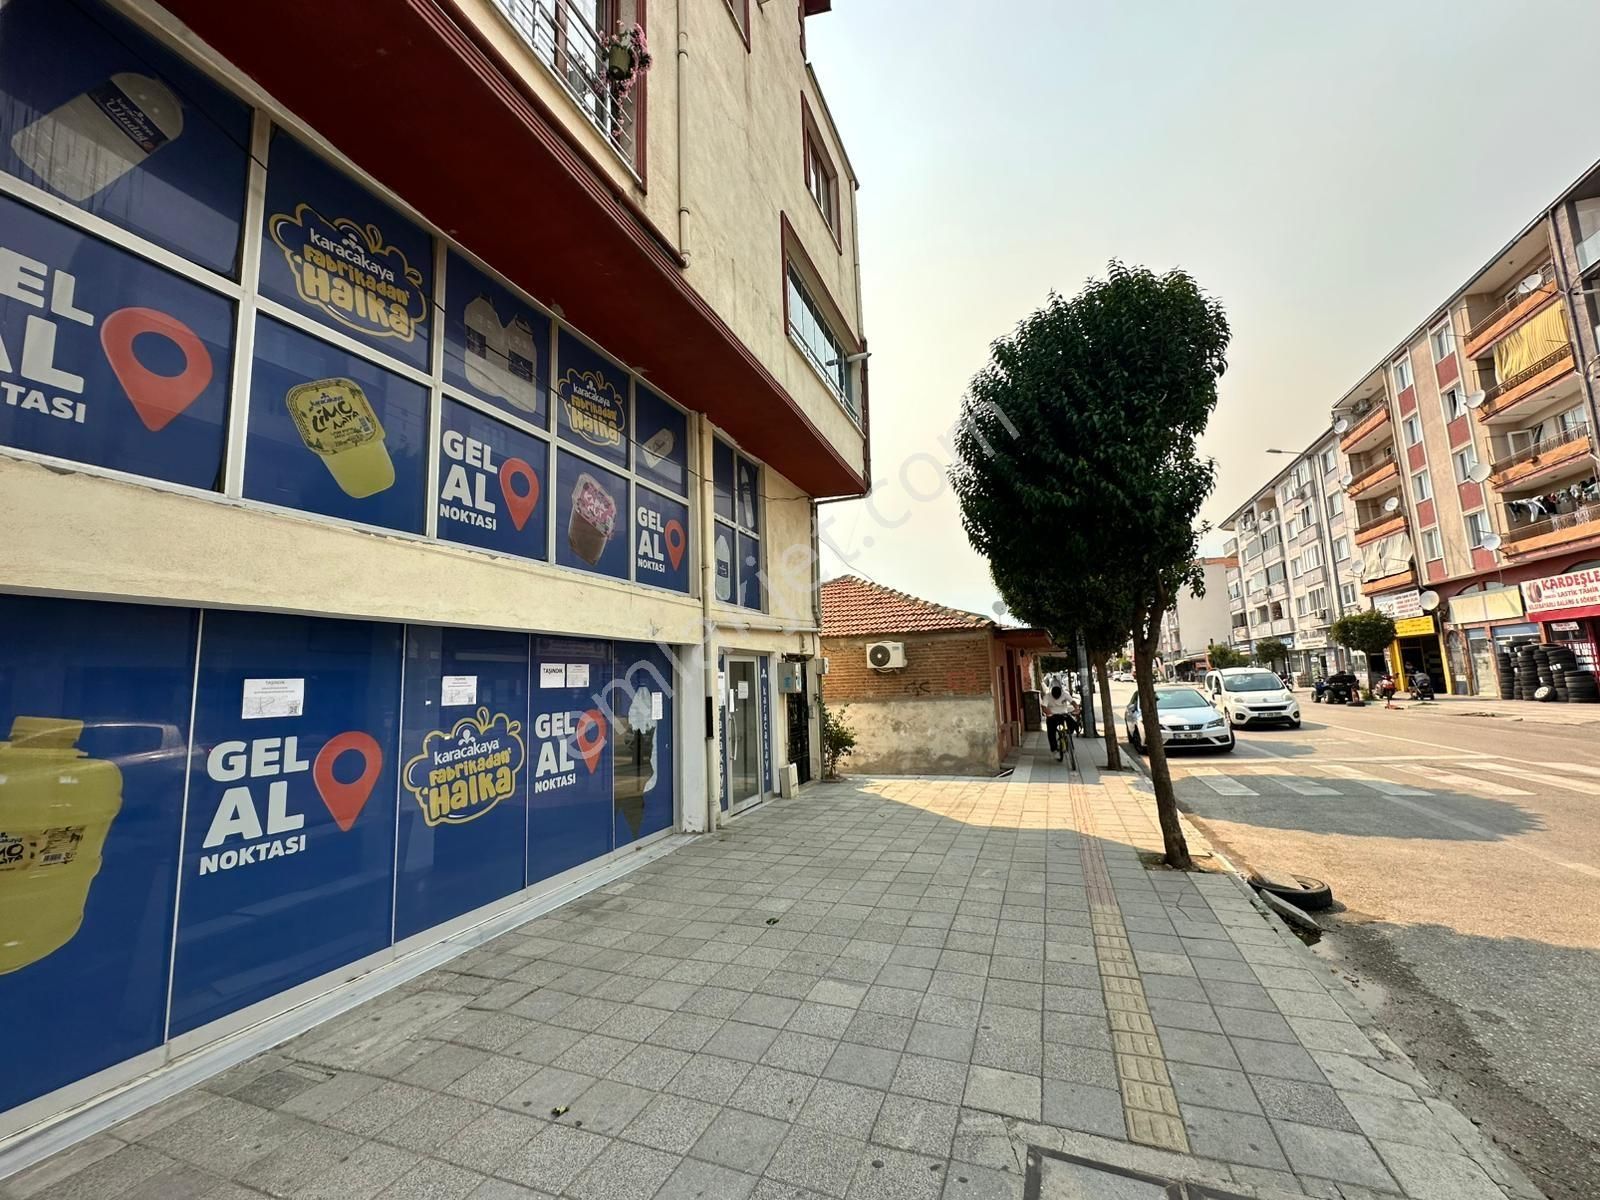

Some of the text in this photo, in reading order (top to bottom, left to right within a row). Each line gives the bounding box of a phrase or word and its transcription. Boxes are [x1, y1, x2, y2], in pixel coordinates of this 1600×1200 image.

[310, 228, 394, 282] karacakaya
[303, 262, 410, 335] Halka
[0, 315, 84, 394] L
[573, 382, 610, 407] karacakaya
[442, 430, 498, 474] GEL
[440, 465, 496, 514] AL
[439, 503, 497, 531] NOKTASI
[637, 507, 664, 533] GEL
[637, 557, 666, 574] NOKTASI
[638, 531, 664, 561] AL
[534, 711, 577, 738] GEL
[206, 736, 310, 782] GEL
[434, 738, 499, 766] karacakaya
[535, 738, 575, 778] AL
[428, 768, 512, 819] Halka
[534, 773, 577, 793] NOKTASI
[202, 780, 305, 848] AL
[199, 834, 306, 876] NOKTASI
